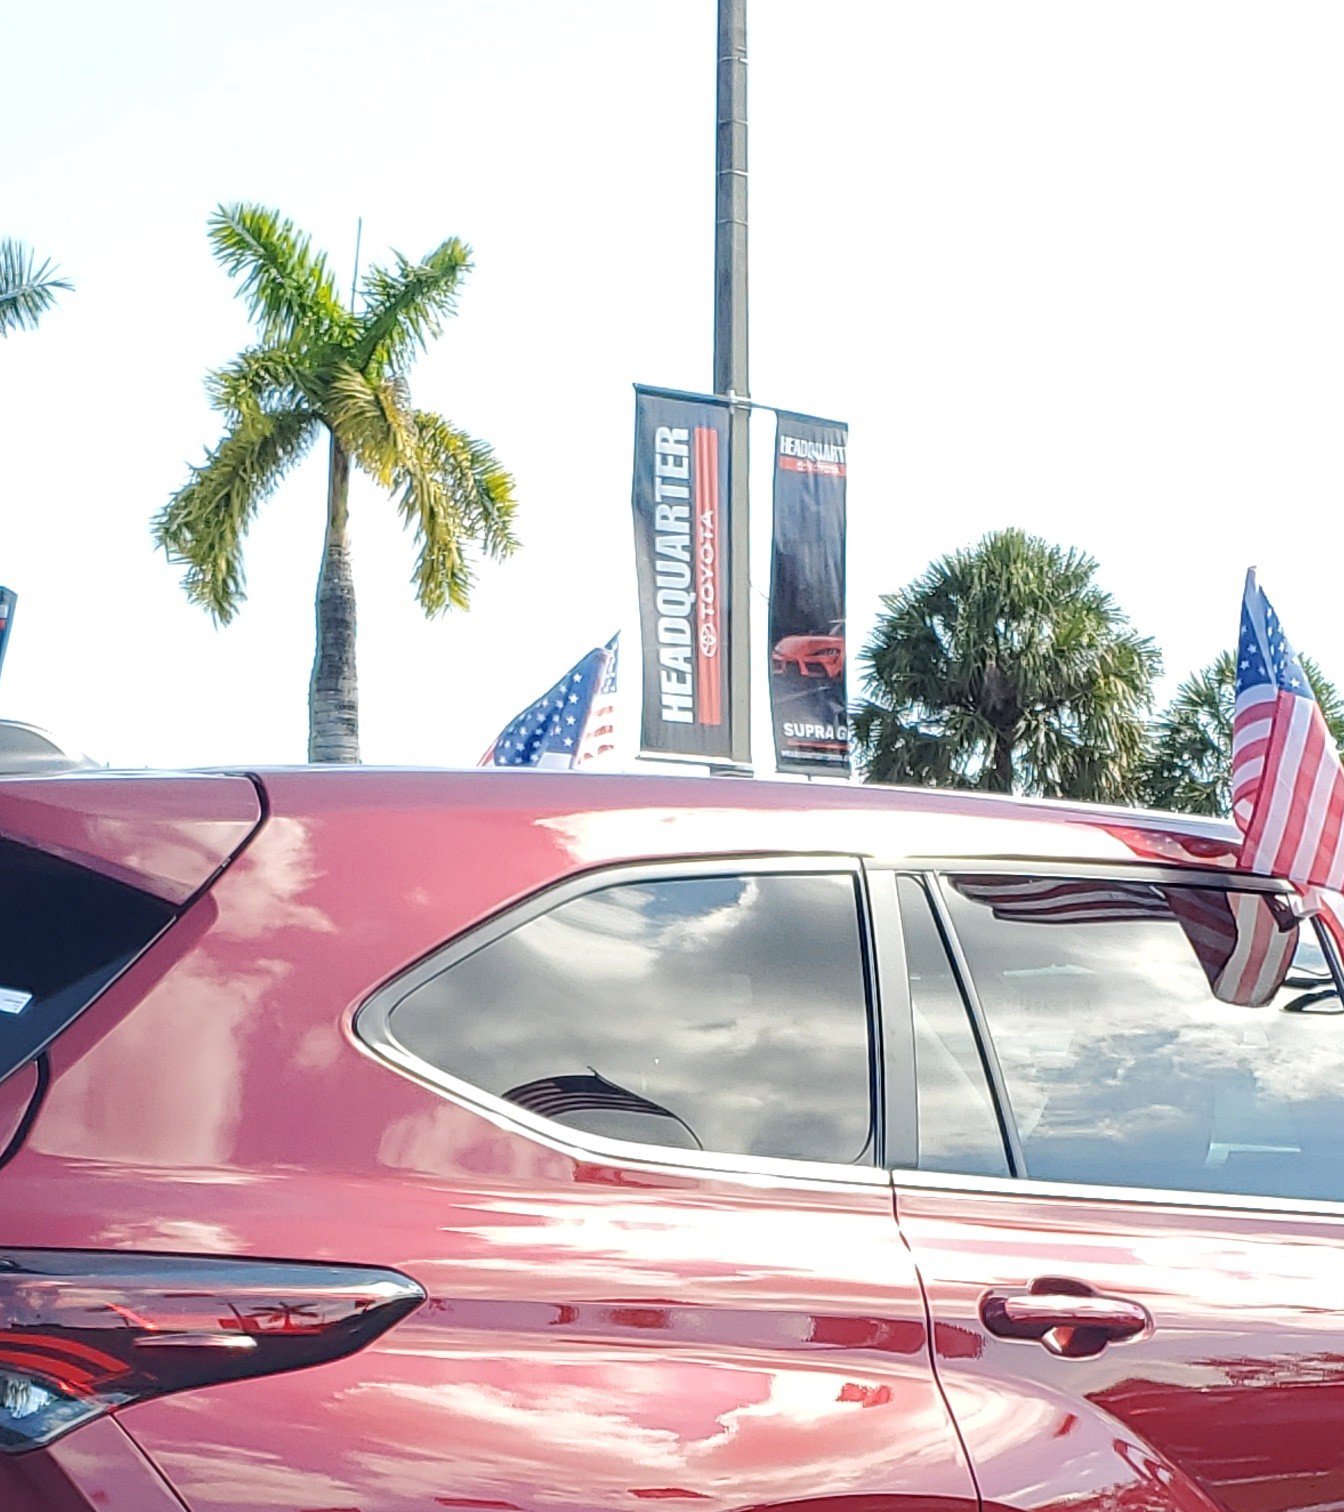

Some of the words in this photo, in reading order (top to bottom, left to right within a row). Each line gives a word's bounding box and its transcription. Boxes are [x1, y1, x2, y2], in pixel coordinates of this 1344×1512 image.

[780, 435, 846, 464] HEADQUART
[655, 427, 696, 724] HEADQUARTER
[699, 509, 717, 620] TOYOTA
[783, 722, 834, 740] SUPRA
